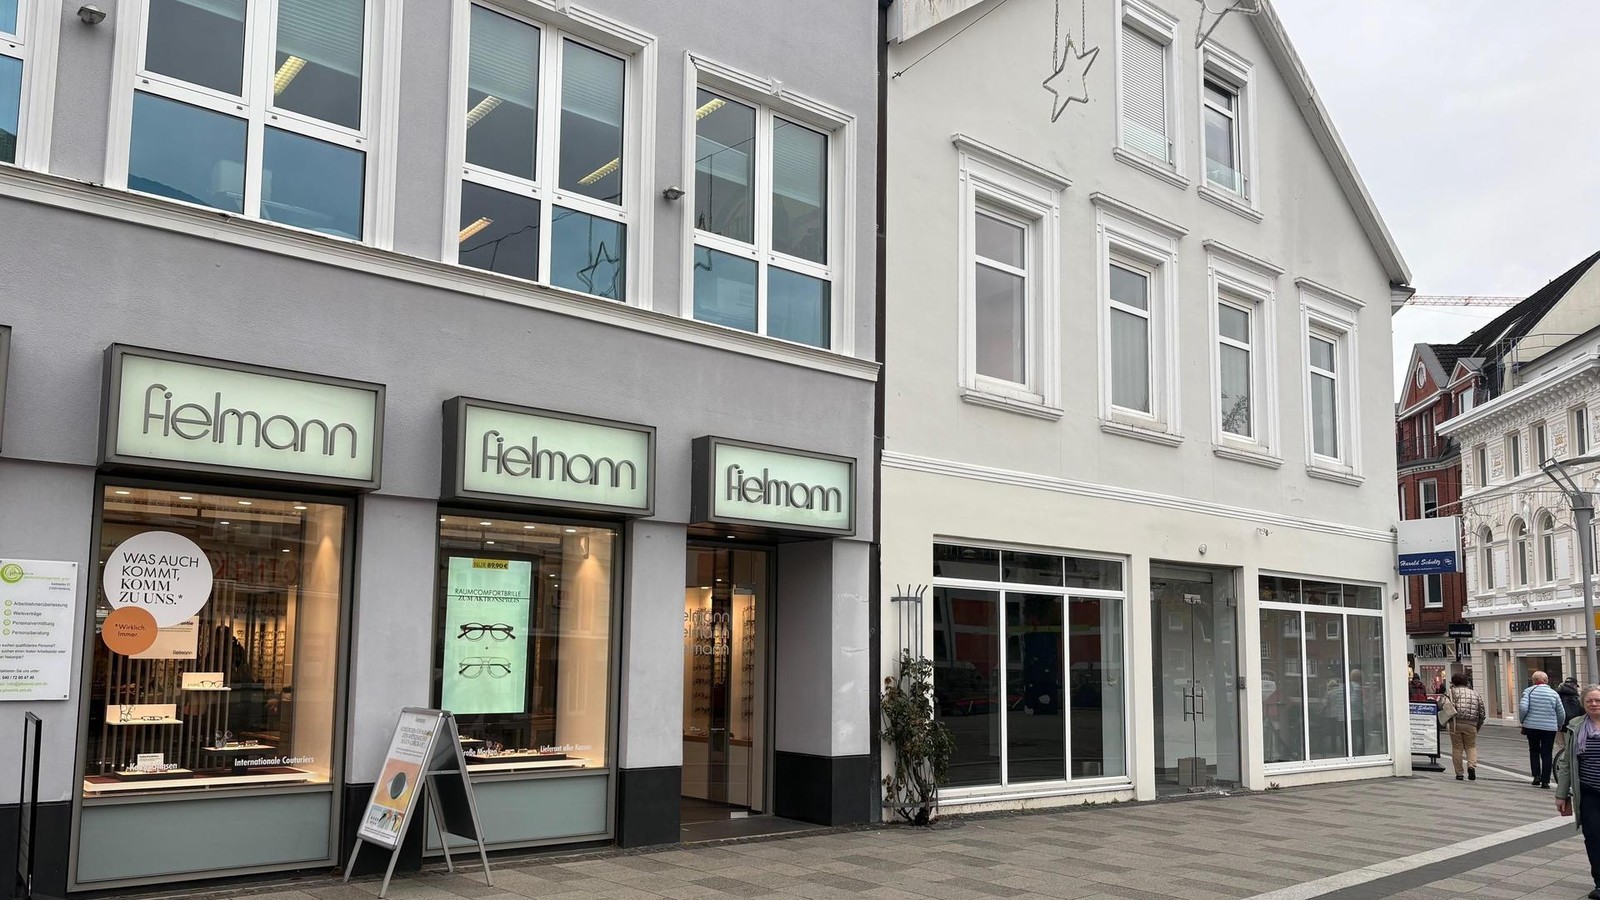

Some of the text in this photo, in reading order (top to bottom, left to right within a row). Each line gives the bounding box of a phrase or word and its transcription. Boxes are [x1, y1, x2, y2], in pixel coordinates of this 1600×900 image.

[123, 552, 199, 568] WAS AUCH
[121, 565, 180, 581] KOMMT,
[120, 578, 171, 592] KOMM
[118, 591, 140, 603] ZU
[455, 588, 521, 597] RAUMCOMFORTBRILLE
[1509, 618, 1556, 632] GERRY WEBER
[234, 756, 314, 767] Internationale Couturiers
